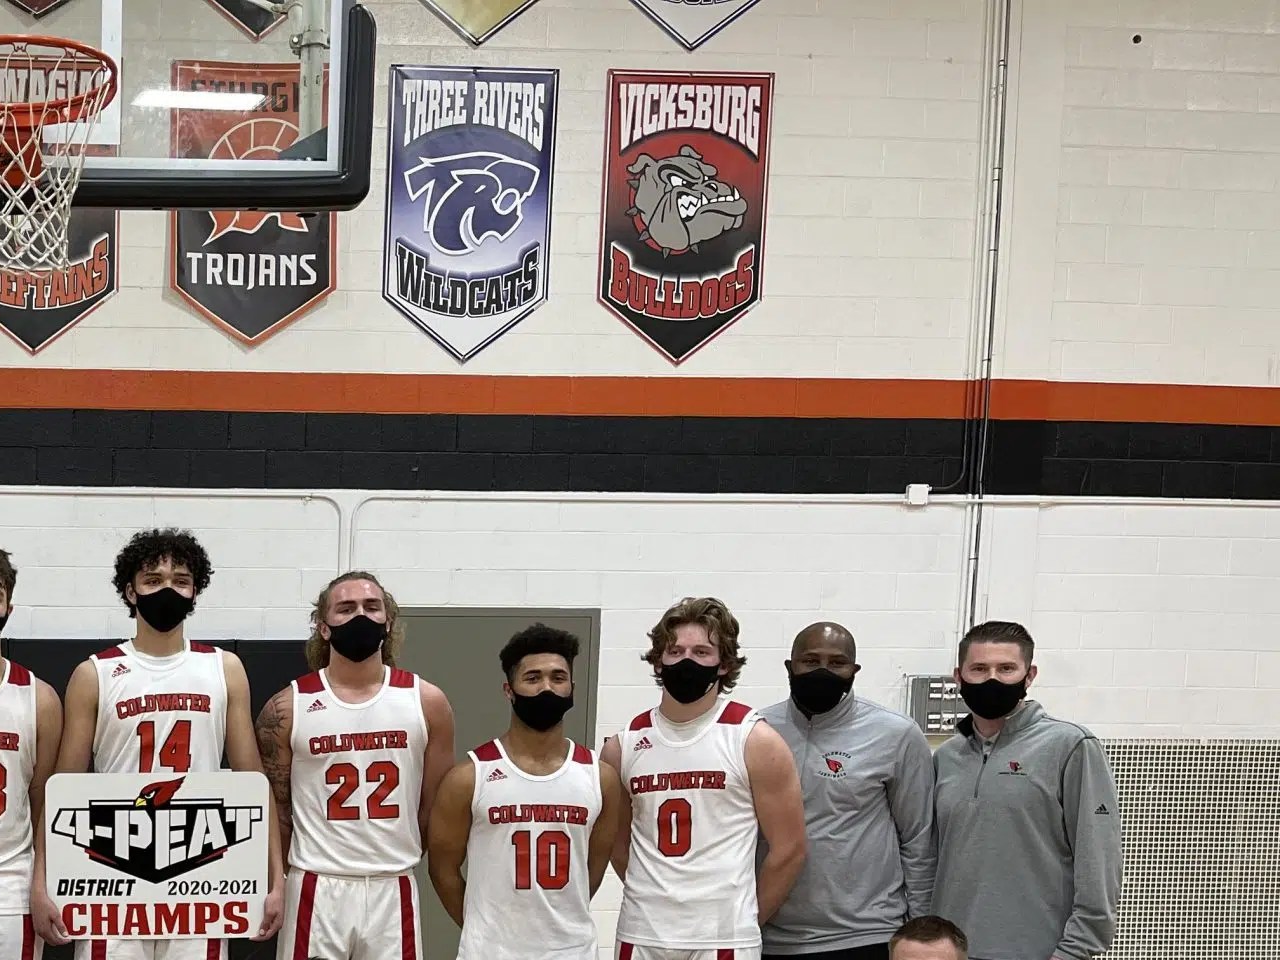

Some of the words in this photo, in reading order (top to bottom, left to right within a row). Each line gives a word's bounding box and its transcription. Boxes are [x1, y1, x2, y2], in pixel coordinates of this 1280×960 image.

[403, 79, 468, 147] THREE
[473, 81, 545, 151] RIVERS
[619, 83, 762, 159] VICKSBURG
[186, 252, 317, 291] TROJANS
[396, 241, 541, 317] WILDCATS
[609, 242, 755, 320] BULLDOGS
[116, 693, 211, 720] COLDWATER
[136, 720, 192, 773] 14
[309, 730, 408, 755] COLDWATER
[324, 760, 400, 821] 22
[630, 771, 727, 795] COLDWATER
[52, 807, 263, 871] 4-PEAT
[488, 804, 588, 826] COLDWATER
[657, 798, 692, 857] 0
[57, 879, 136, 897] DISTRICT
[167, 880, 258, 896] 2020-2021
[511, 830, 571, 890] 10
[61, 901, 249, 936] CHAMPS
